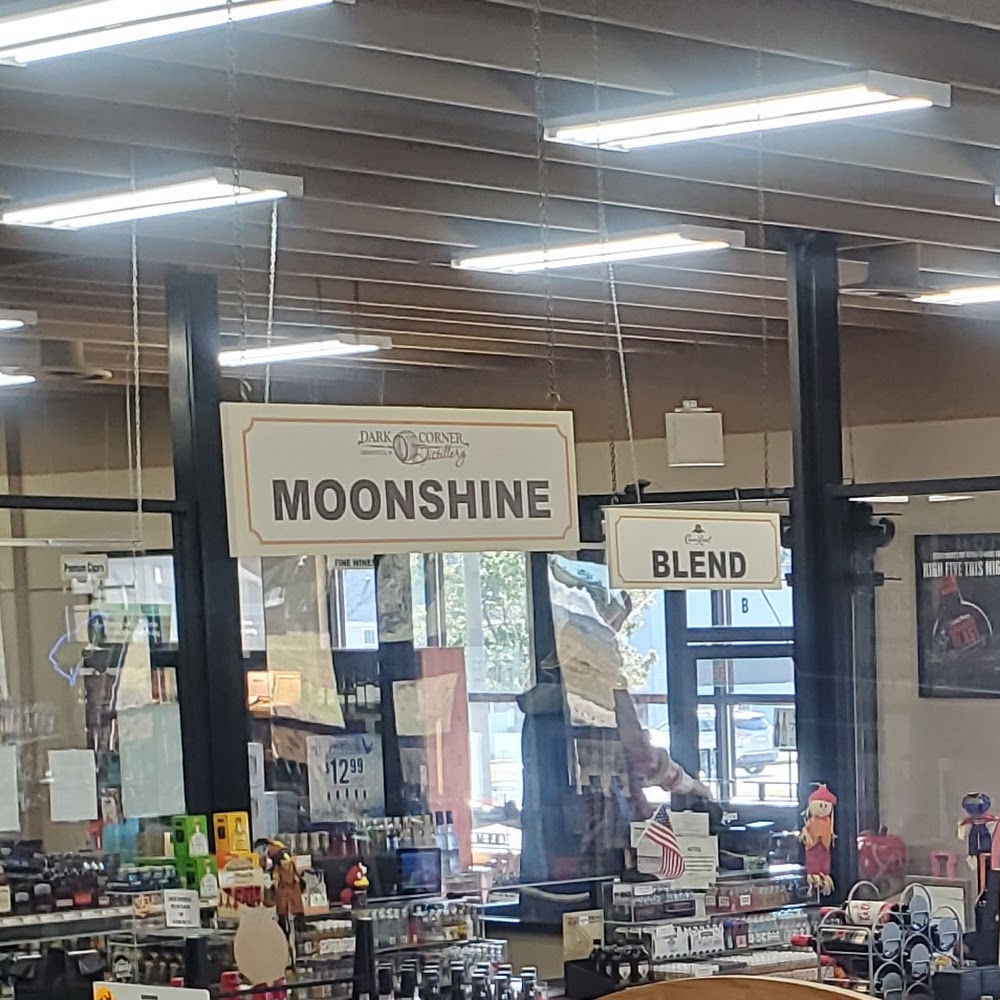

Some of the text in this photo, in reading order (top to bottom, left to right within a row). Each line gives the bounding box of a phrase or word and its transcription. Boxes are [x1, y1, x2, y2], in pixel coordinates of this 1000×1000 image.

[359, 430, 469, 447] DARK CORNER
[412, 444, 468, 468] Distillery
[272, 478, 552, 521] MOONSHINE
[335, 559, 351, 567] FINE
[652, 550, 746, 578] BLEND
[923, 562, 943, 578] HIGH
[945, 561, 962, 577] FIVE
[964, 561, 983, 577] THIS
[741, 597, 749, 614] B
